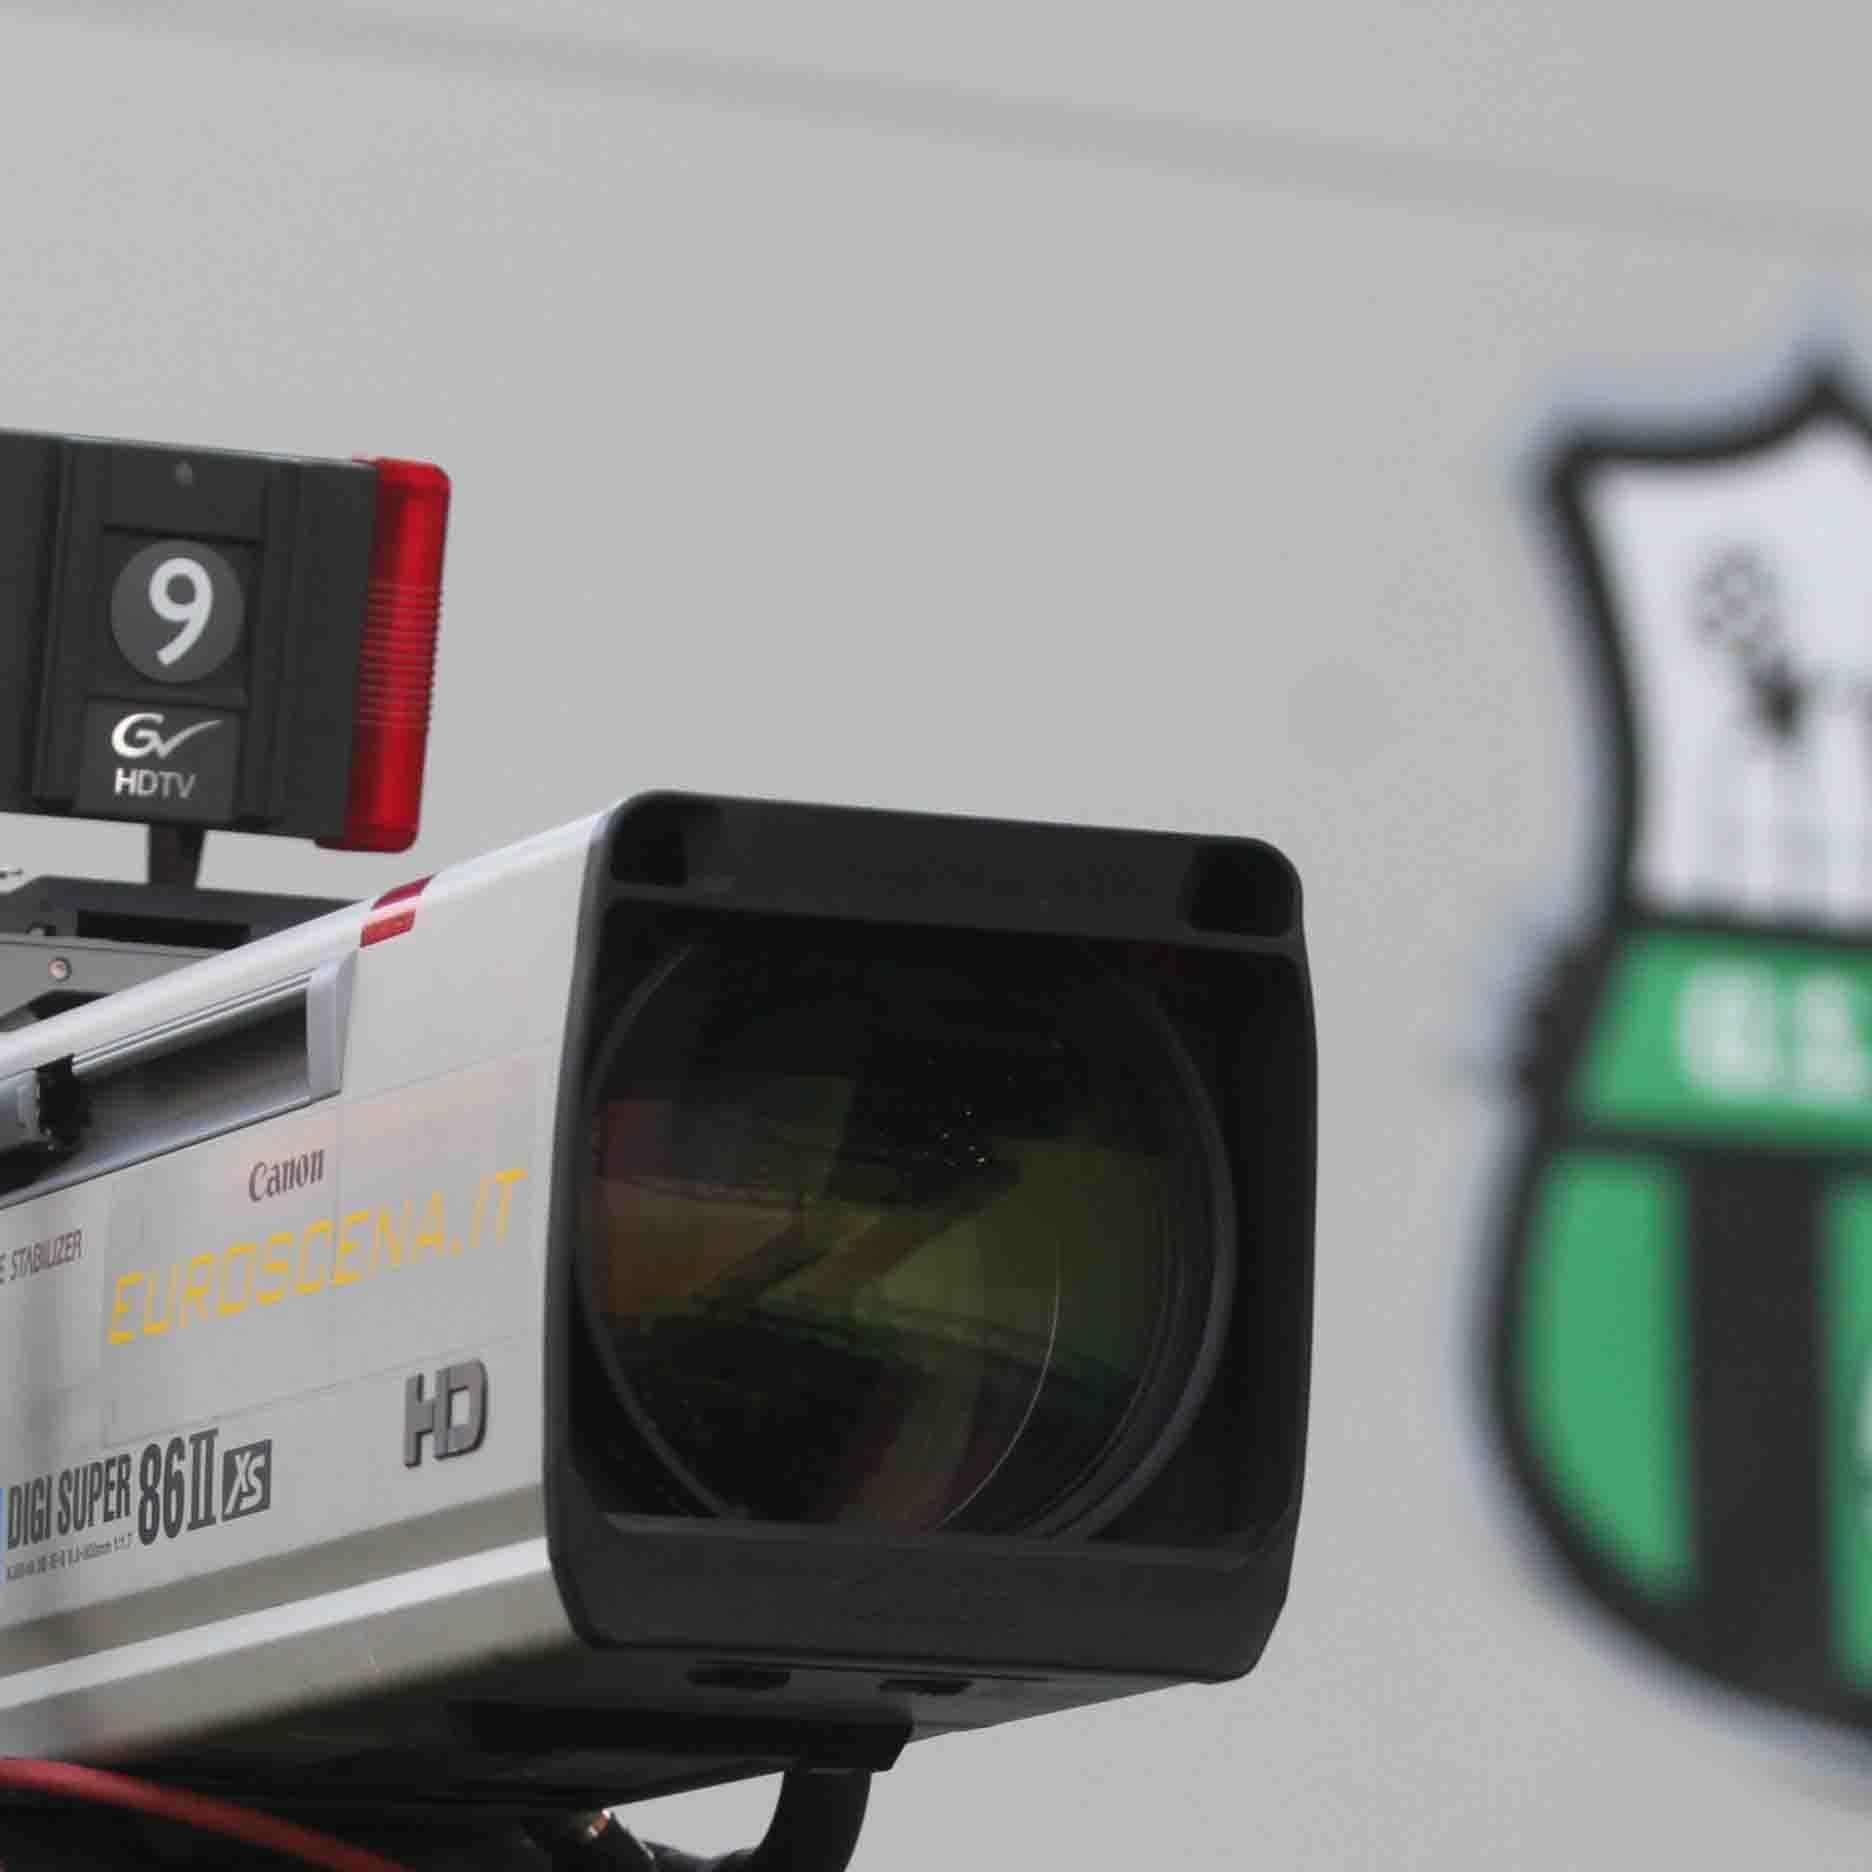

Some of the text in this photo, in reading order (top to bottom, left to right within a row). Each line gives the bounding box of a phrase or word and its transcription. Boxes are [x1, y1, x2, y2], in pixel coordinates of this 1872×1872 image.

[147, 555, 215, 666] 9
[114, 767, 198, 799] HDTV
[248, 1147, 326, 1202] Canon
[8, 1229, 82, 1281] STABILIZER
[107, 1167, 526, 1345] EUROSCENA.IT
[403, 1357, 489, 1467] HD
[7, 1474, 53, 1550] DIGI
[57, 1453, 132, 1536] SUPER
